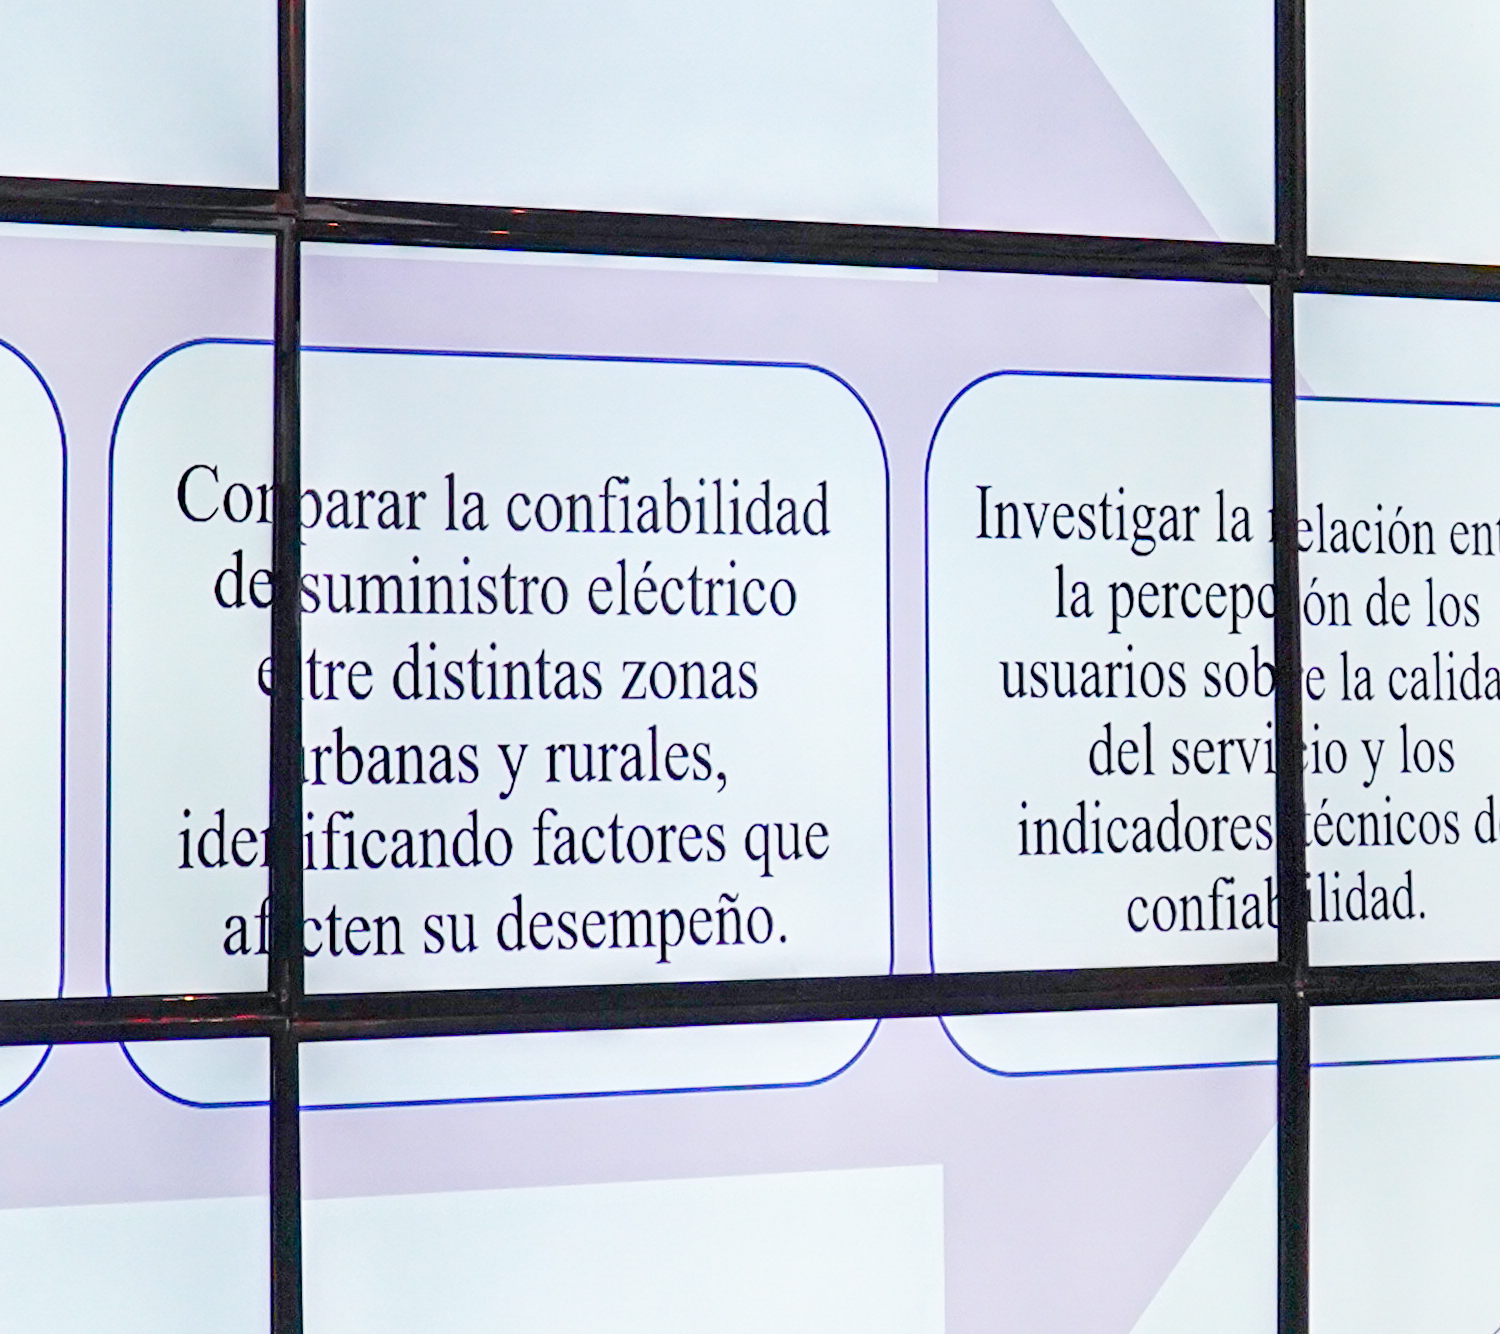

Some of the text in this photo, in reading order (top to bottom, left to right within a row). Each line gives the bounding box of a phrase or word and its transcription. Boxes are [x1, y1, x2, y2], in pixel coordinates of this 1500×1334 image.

[445, 473, 488, 532] la
[507, 476, 831, 536] confiabilidad
[976, 485, 1200, 556] Investigar
[1216, 489, 1253, 542] la
[299, 556, 569, 615] suministro
[587, 559, 797, 617] eléctrico
[1054, 564, 1480, 634] la percepcón de los
[257, 643, 759, 700] etre distintas zonas
[1000, 644, 1186, 700] usuarios
[1203, 644, 1326, 702] sobe
[1341, 650, 1374, 701] la
[500, 742, 528, 799] y
[545, 725, 727, 794] rurales,
[1088, 720, 1455, 788] del serviio y los
[178, 807, 830, 877] ideificando factores que
[1018, 799, 1274, 855] indicadores
[223, 894, 788, 963] afcten su desempeño.
